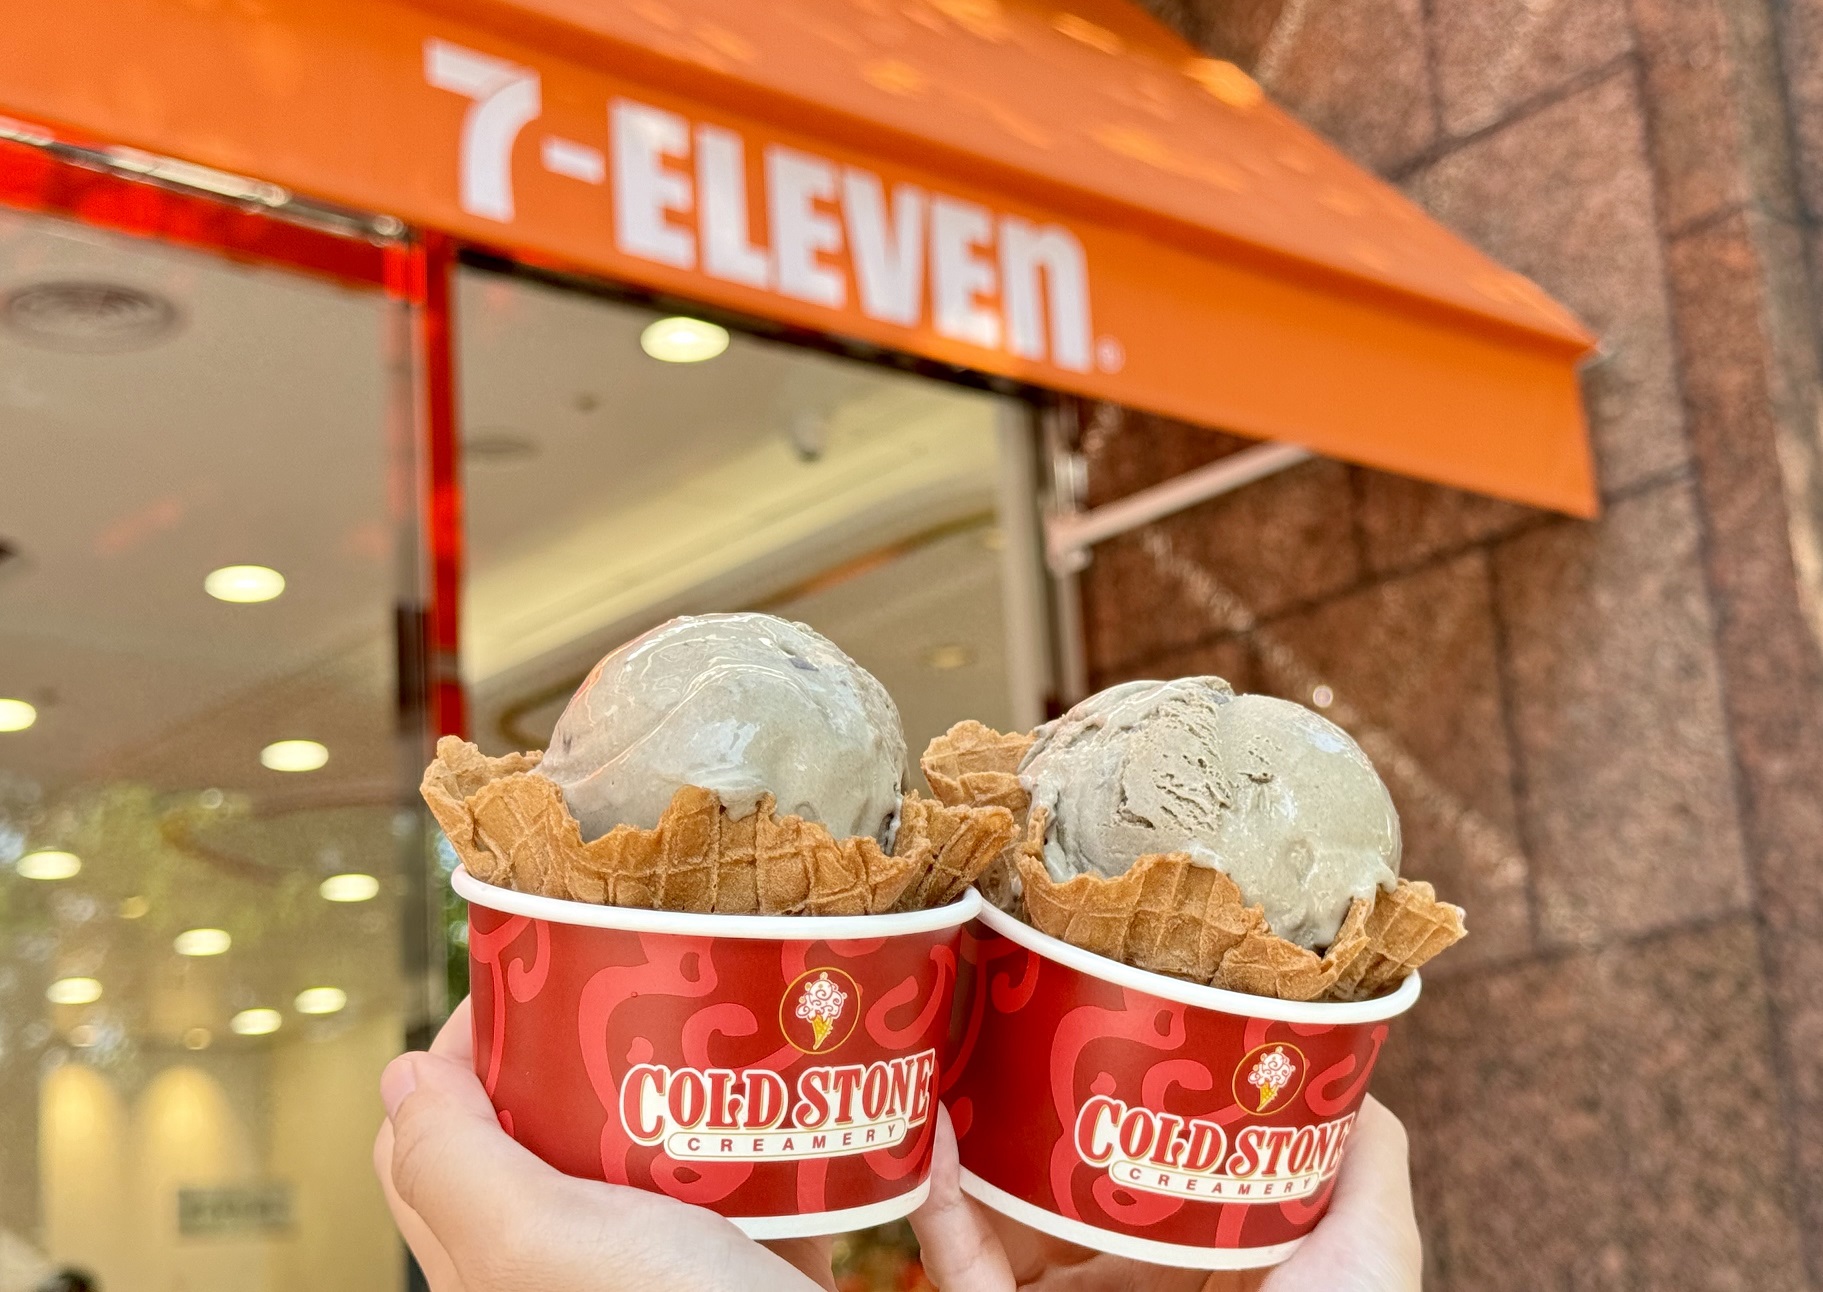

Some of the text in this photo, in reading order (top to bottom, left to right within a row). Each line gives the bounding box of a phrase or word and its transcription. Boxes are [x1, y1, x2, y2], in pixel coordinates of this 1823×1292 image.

[621, 1049, 935, 1143] COLD STONE
[686, 1124, 897, 1153] CREAMERY
[1076, 1097, 1224, 1172] COLD
[1128, 1166, 1312, 1196] CREAMERY
